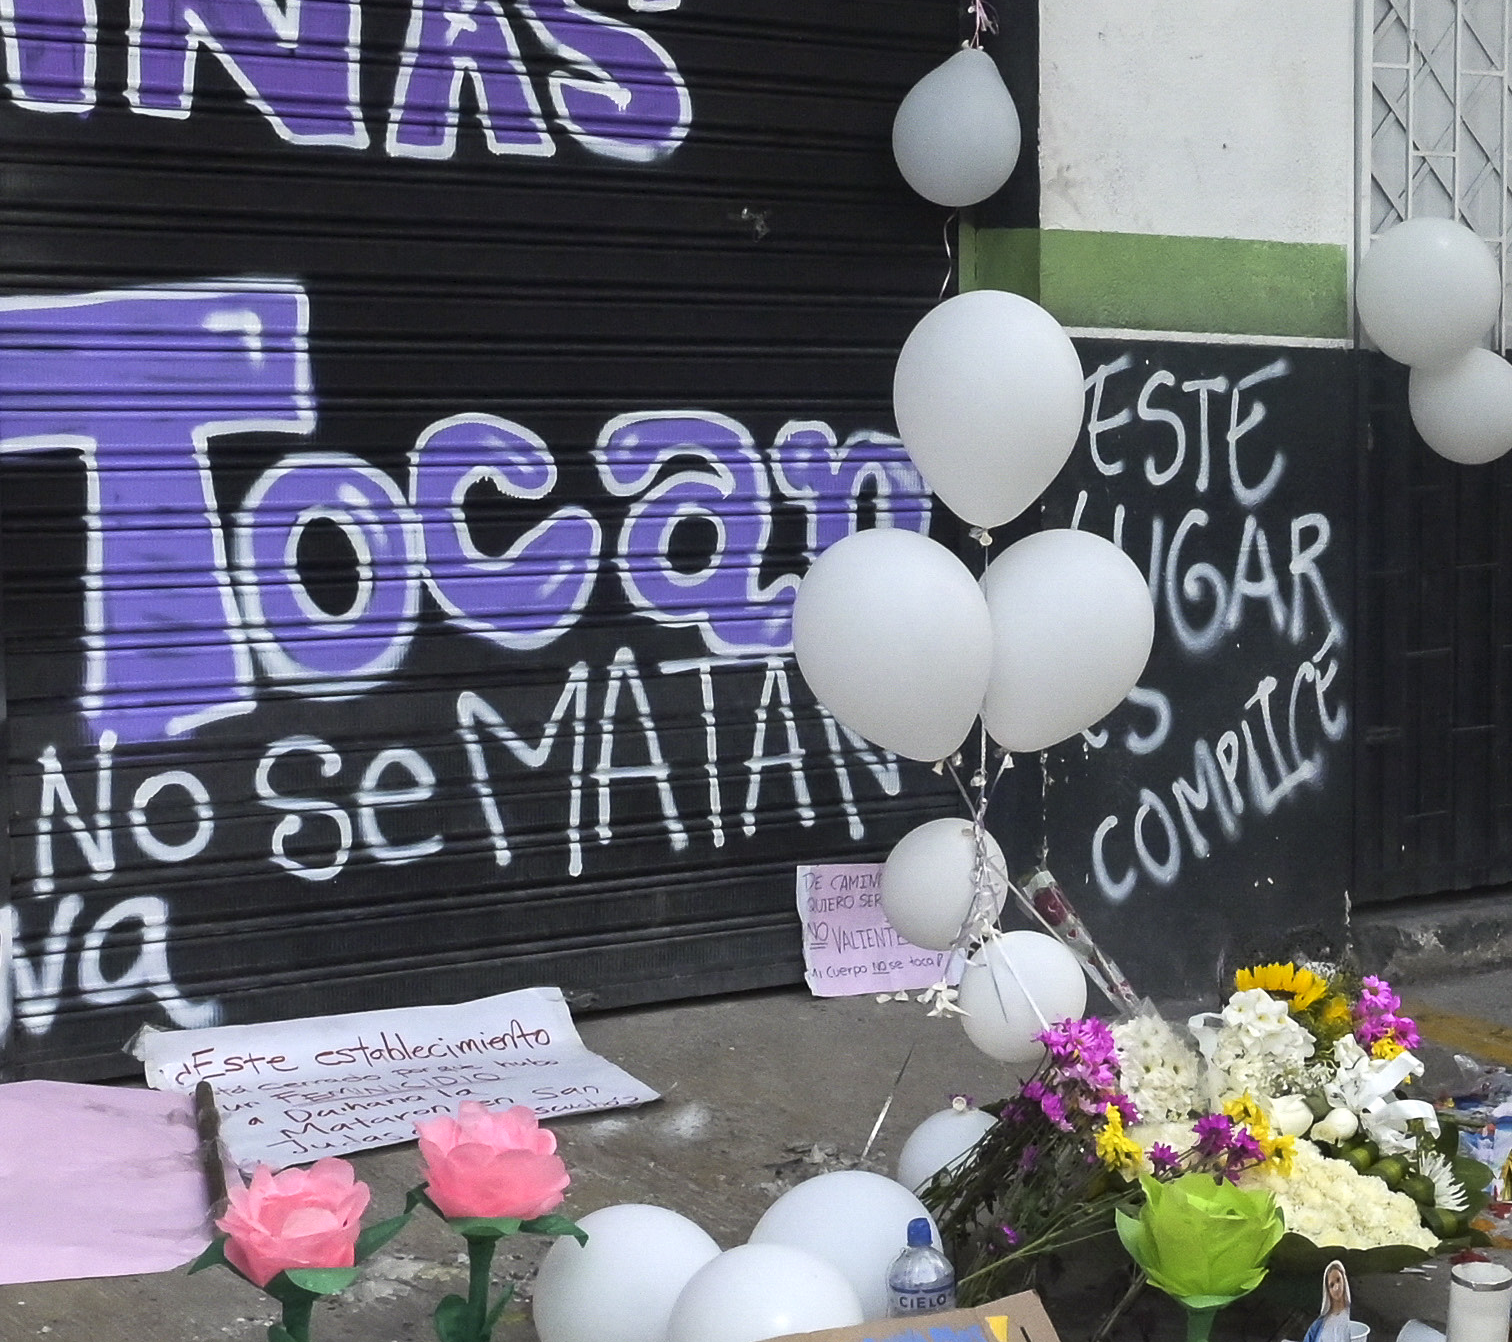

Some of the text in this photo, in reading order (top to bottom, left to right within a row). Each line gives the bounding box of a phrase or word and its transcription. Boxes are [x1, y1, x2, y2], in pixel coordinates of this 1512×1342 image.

[1084, 353, 1288, 506] ESTE
[1071, 491, 1345, 655] UGAR
[34, 645, 900, 900] No Se MATAN
[803, 872, 883, 890] DE CAMIN
[807, 893, 883, 913] QUIERO SER
[807, 921, 829, 942] NO
[314, 1019, 552, 1067] establecimiento
[257, 1073, 382, 1091] cerrado
[248, 1116, 264, 1126] a
[280, 1103, 451, 1139] Mataron
[532, 1085, 600, 1100] San
[899, 1293, 947, 1309] CIELO
